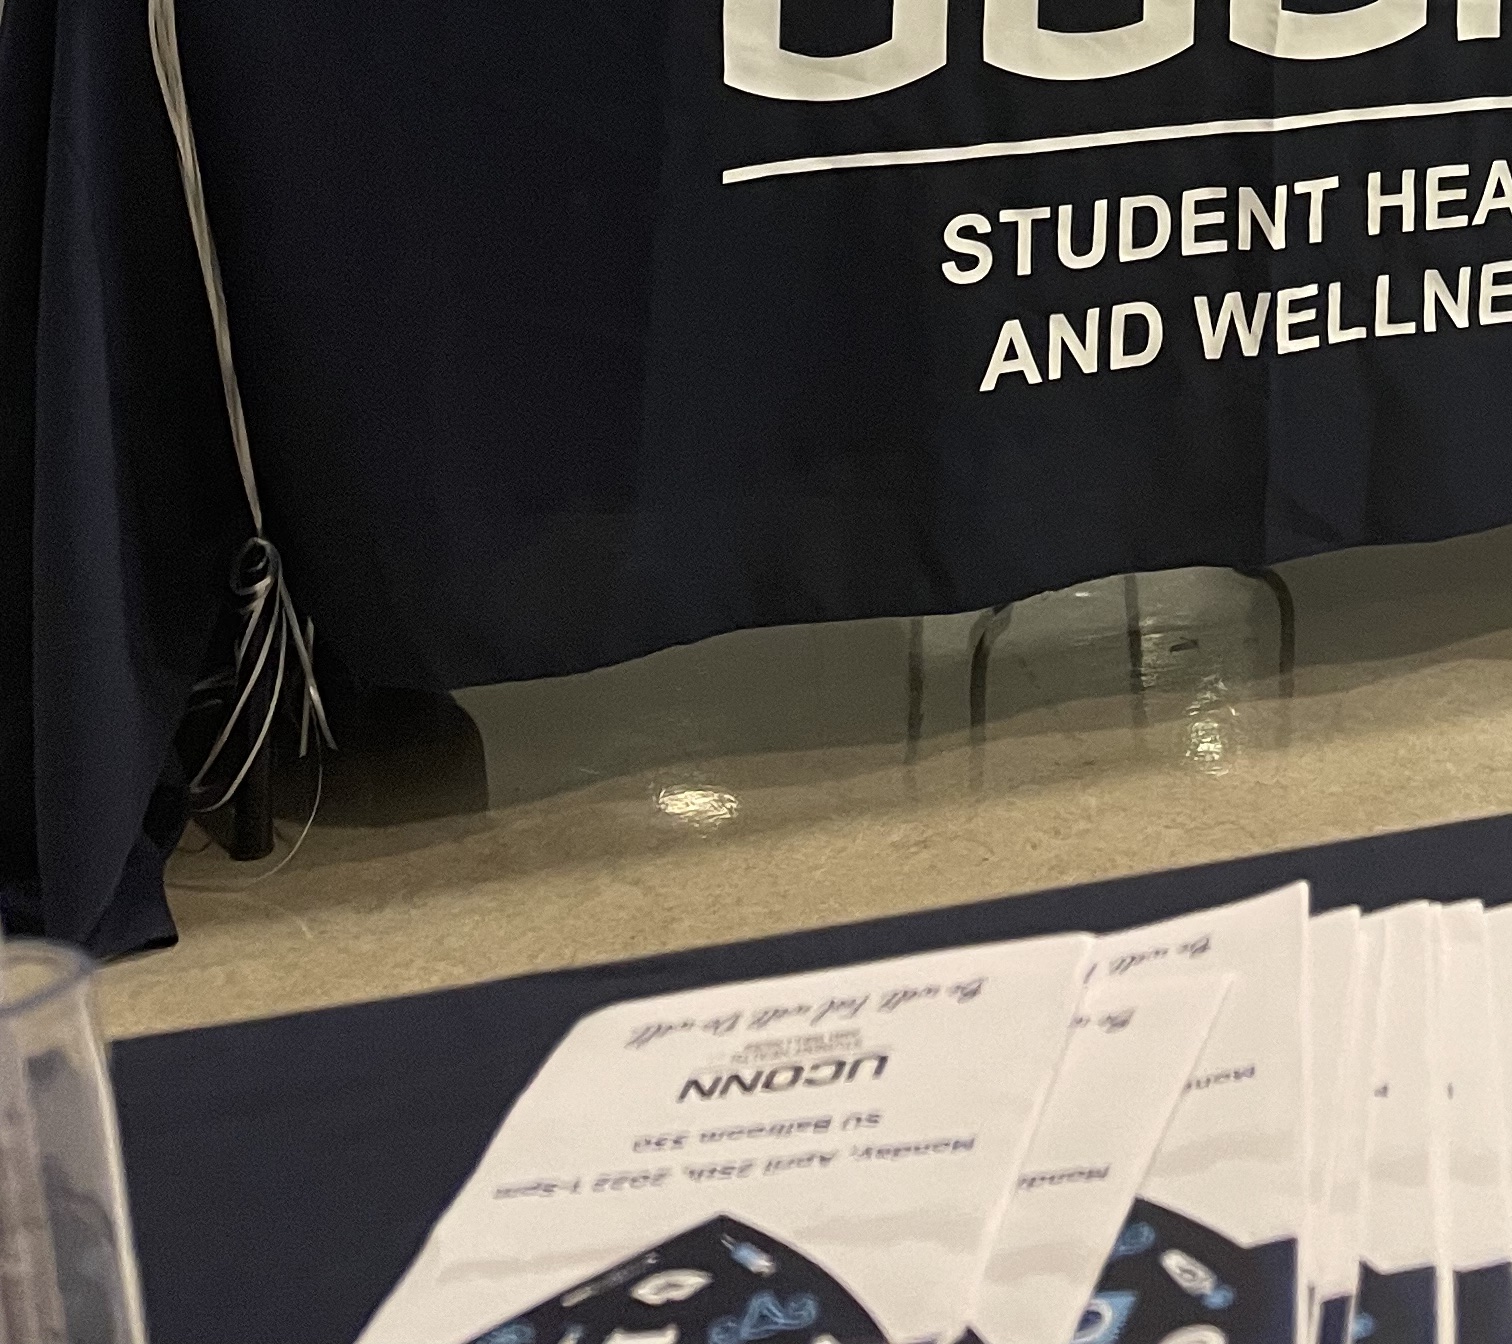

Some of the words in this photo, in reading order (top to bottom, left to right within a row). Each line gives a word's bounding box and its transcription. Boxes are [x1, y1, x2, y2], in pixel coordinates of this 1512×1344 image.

[939, 175, 1339, 287] STUDENT
[980, 301, 1165, 393] AND
[675, 1055, 889, 1104] UCONN
[699, 1116, 833, 1145] Ballroom
[593, 1168, 672, 1195] 2022
[763, 1152, 838, 1177] April
